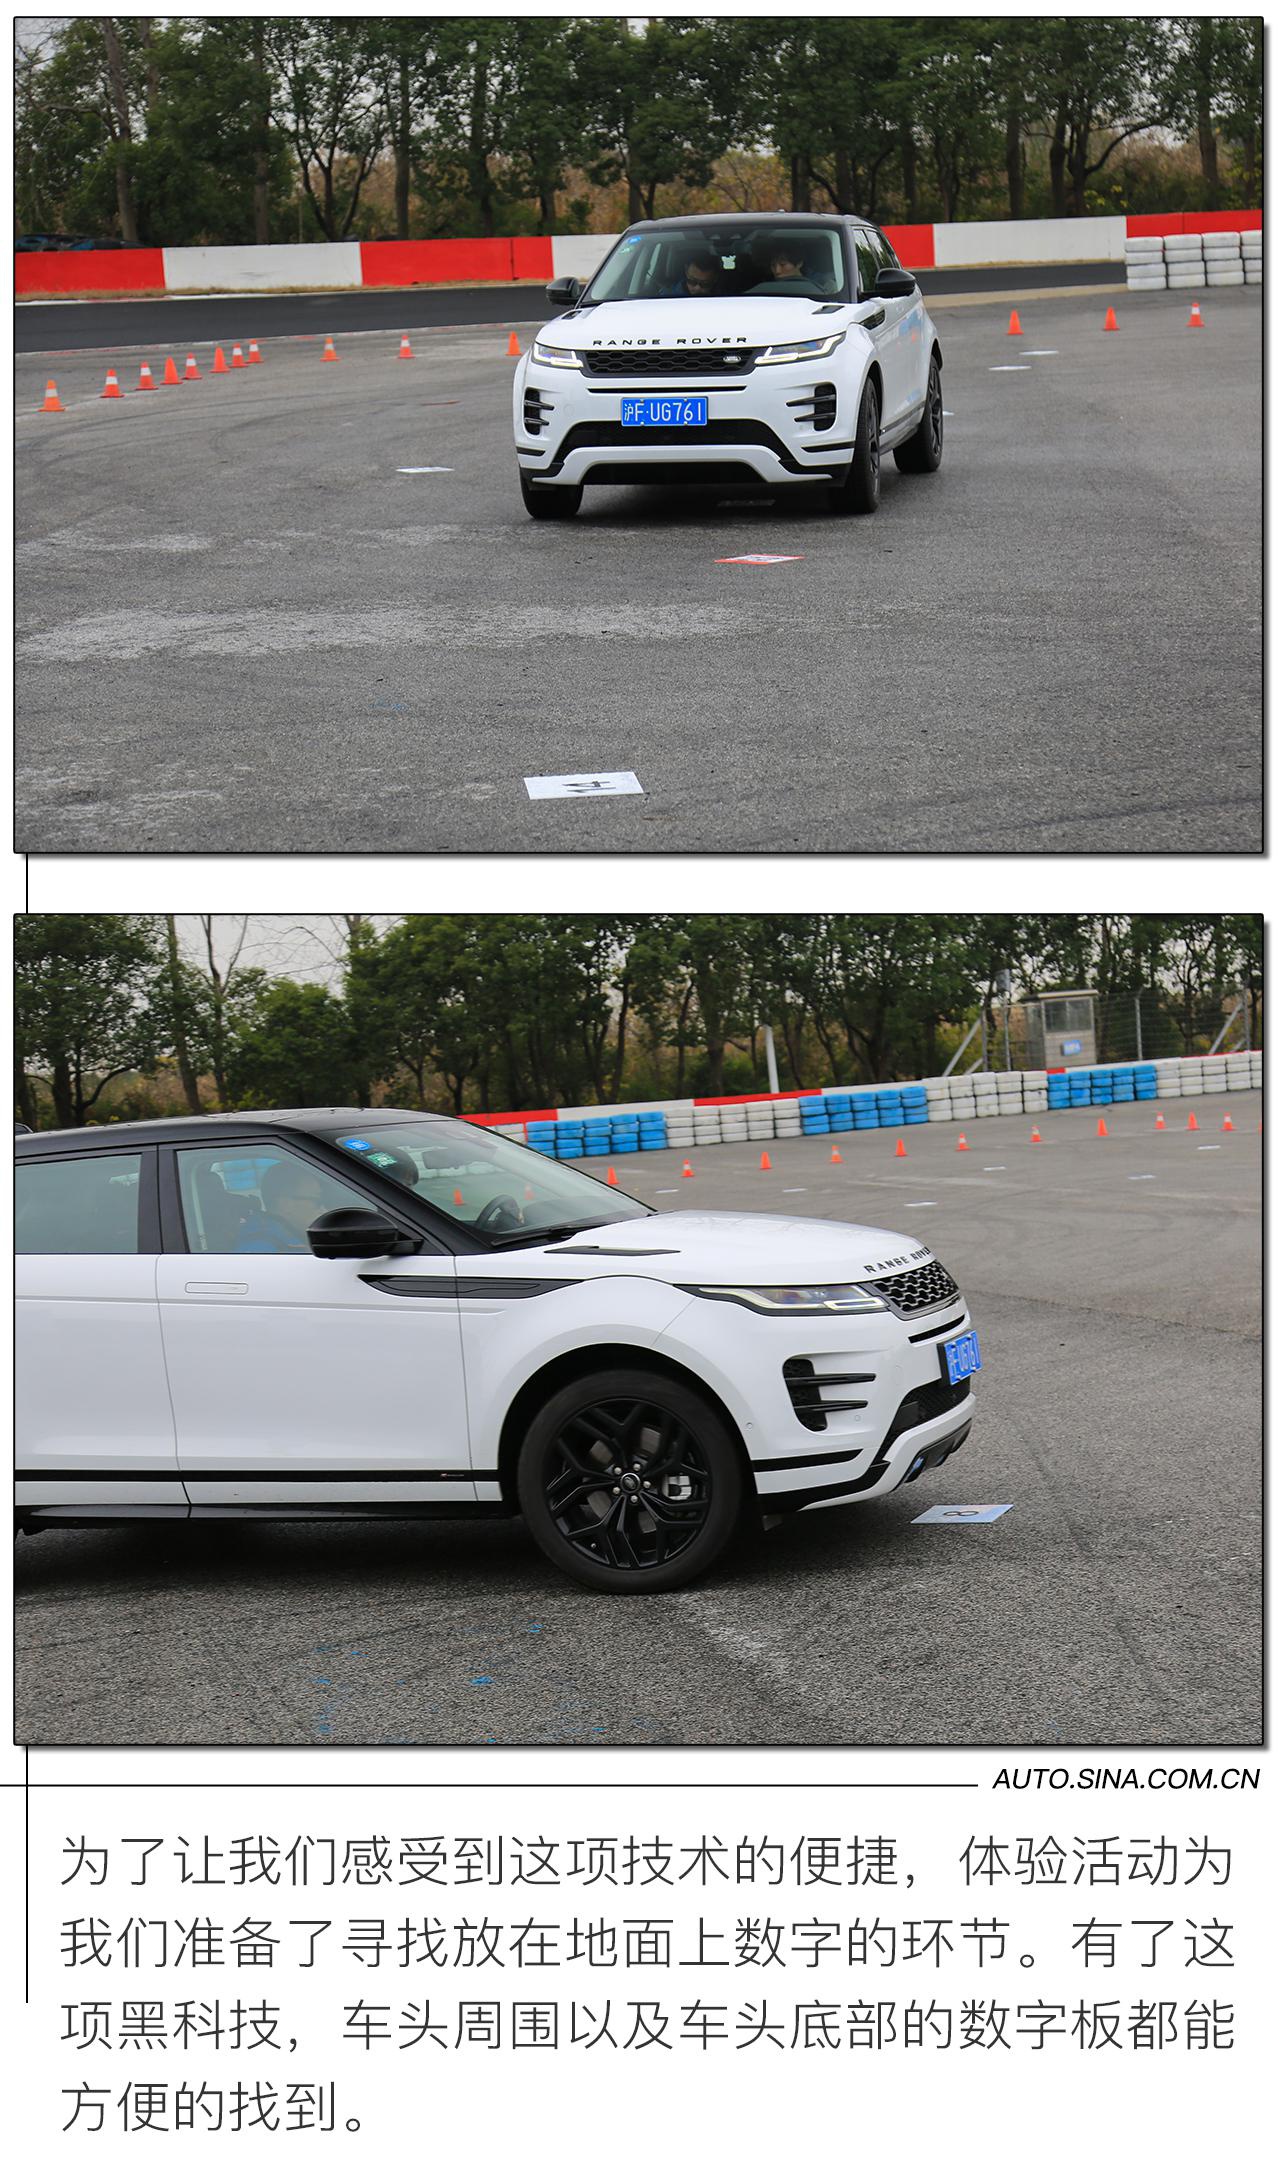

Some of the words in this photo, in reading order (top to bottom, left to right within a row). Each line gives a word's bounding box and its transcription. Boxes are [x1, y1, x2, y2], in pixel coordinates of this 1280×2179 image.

[592, 338, 661, 346] RANGE
[676, 336, 748, 345] ROVER
[863, 1255, 910, 1274] RANGE
